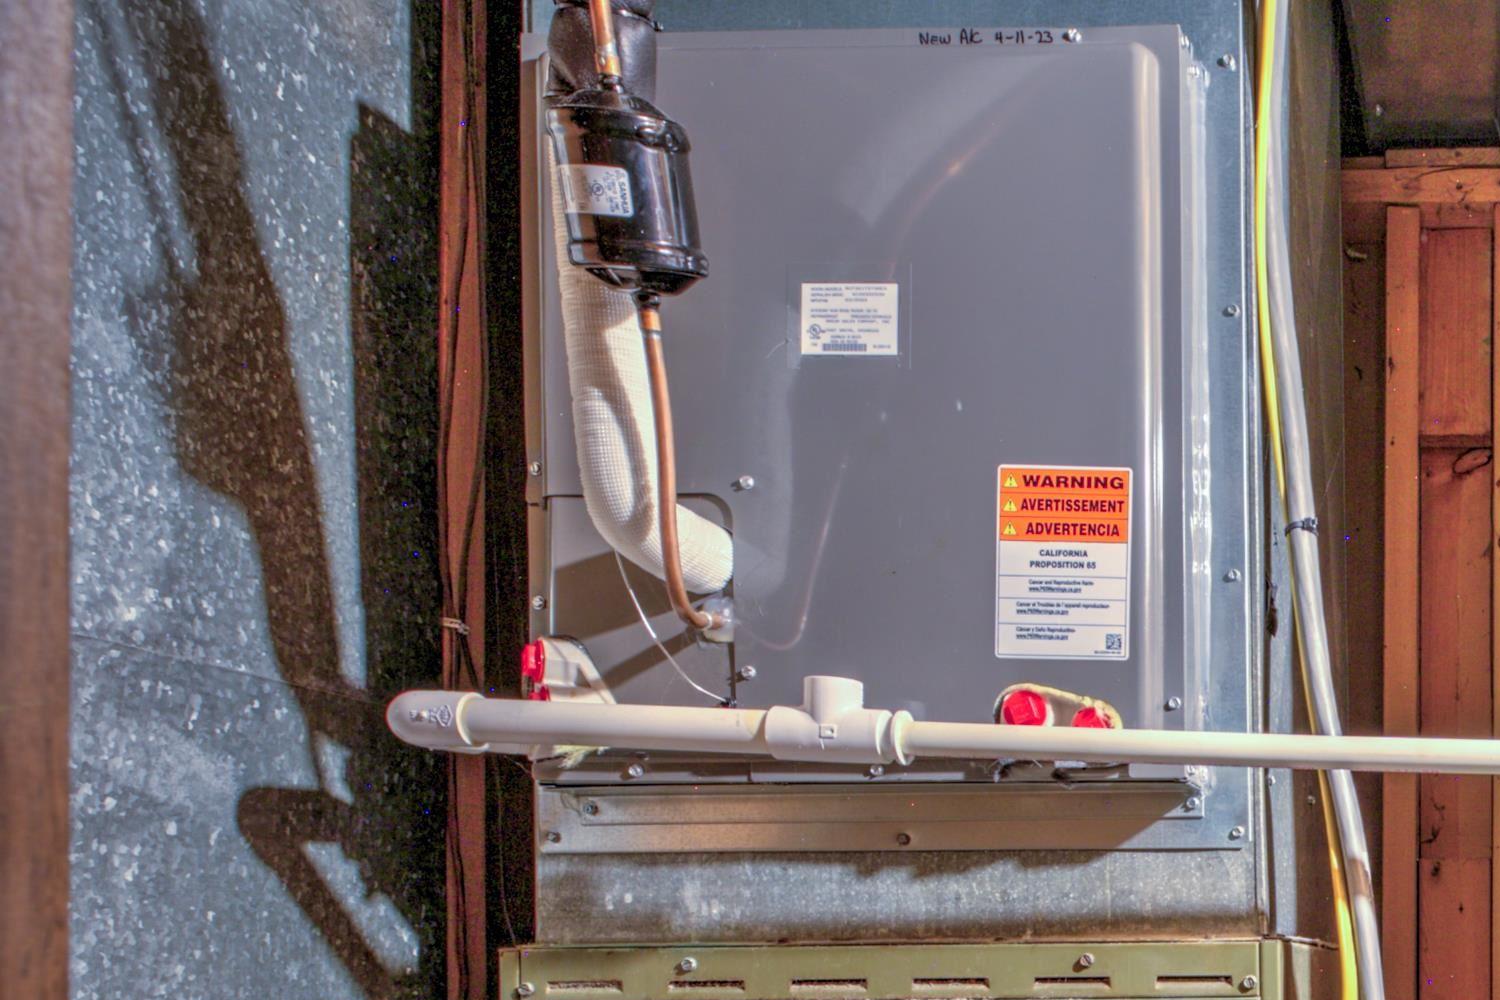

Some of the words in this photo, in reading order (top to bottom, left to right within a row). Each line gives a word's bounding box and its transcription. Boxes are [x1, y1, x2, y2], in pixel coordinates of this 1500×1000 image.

[919, 31, 951, 45] New
[994, 28, 1053, 44] 4-11-23
[1022, 474, 1124, 490] WARNING
[1020, 498, 1125, 513] AVERTISSEMENT
[1025, 522, 1120, 537] ADVERTENCIA
[1039, 549, 1088, 557] CALIFORNIA
[1029, 560, 1085, 570] PROPOSITION
[1086, 562, 1096, 570] 65
